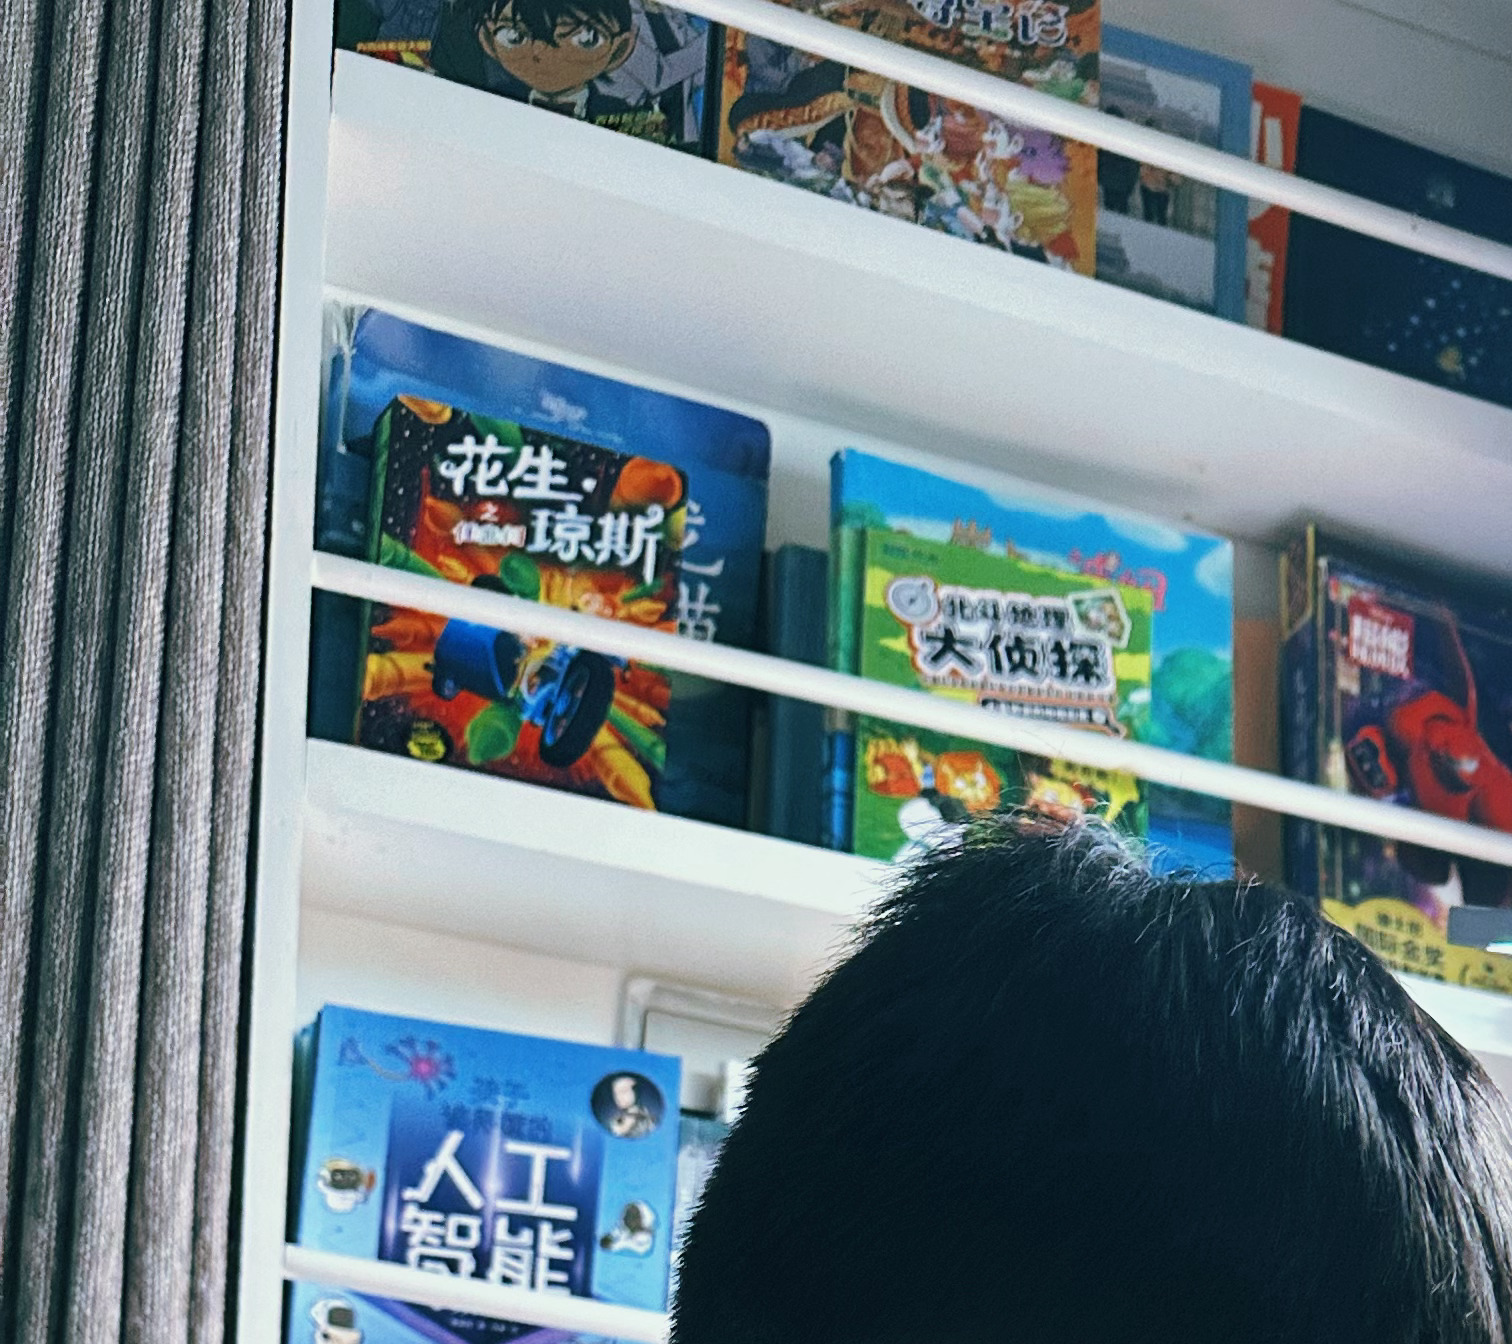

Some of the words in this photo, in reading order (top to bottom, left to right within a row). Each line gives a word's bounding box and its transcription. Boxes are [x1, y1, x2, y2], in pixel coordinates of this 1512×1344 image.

[526, 502, 665, 585] 琼斯
[923, 628, 1104, 684] 大侦探
[400, 1129, 579, 1222] 人工
[400, 1202, 576, 1297] 智能
